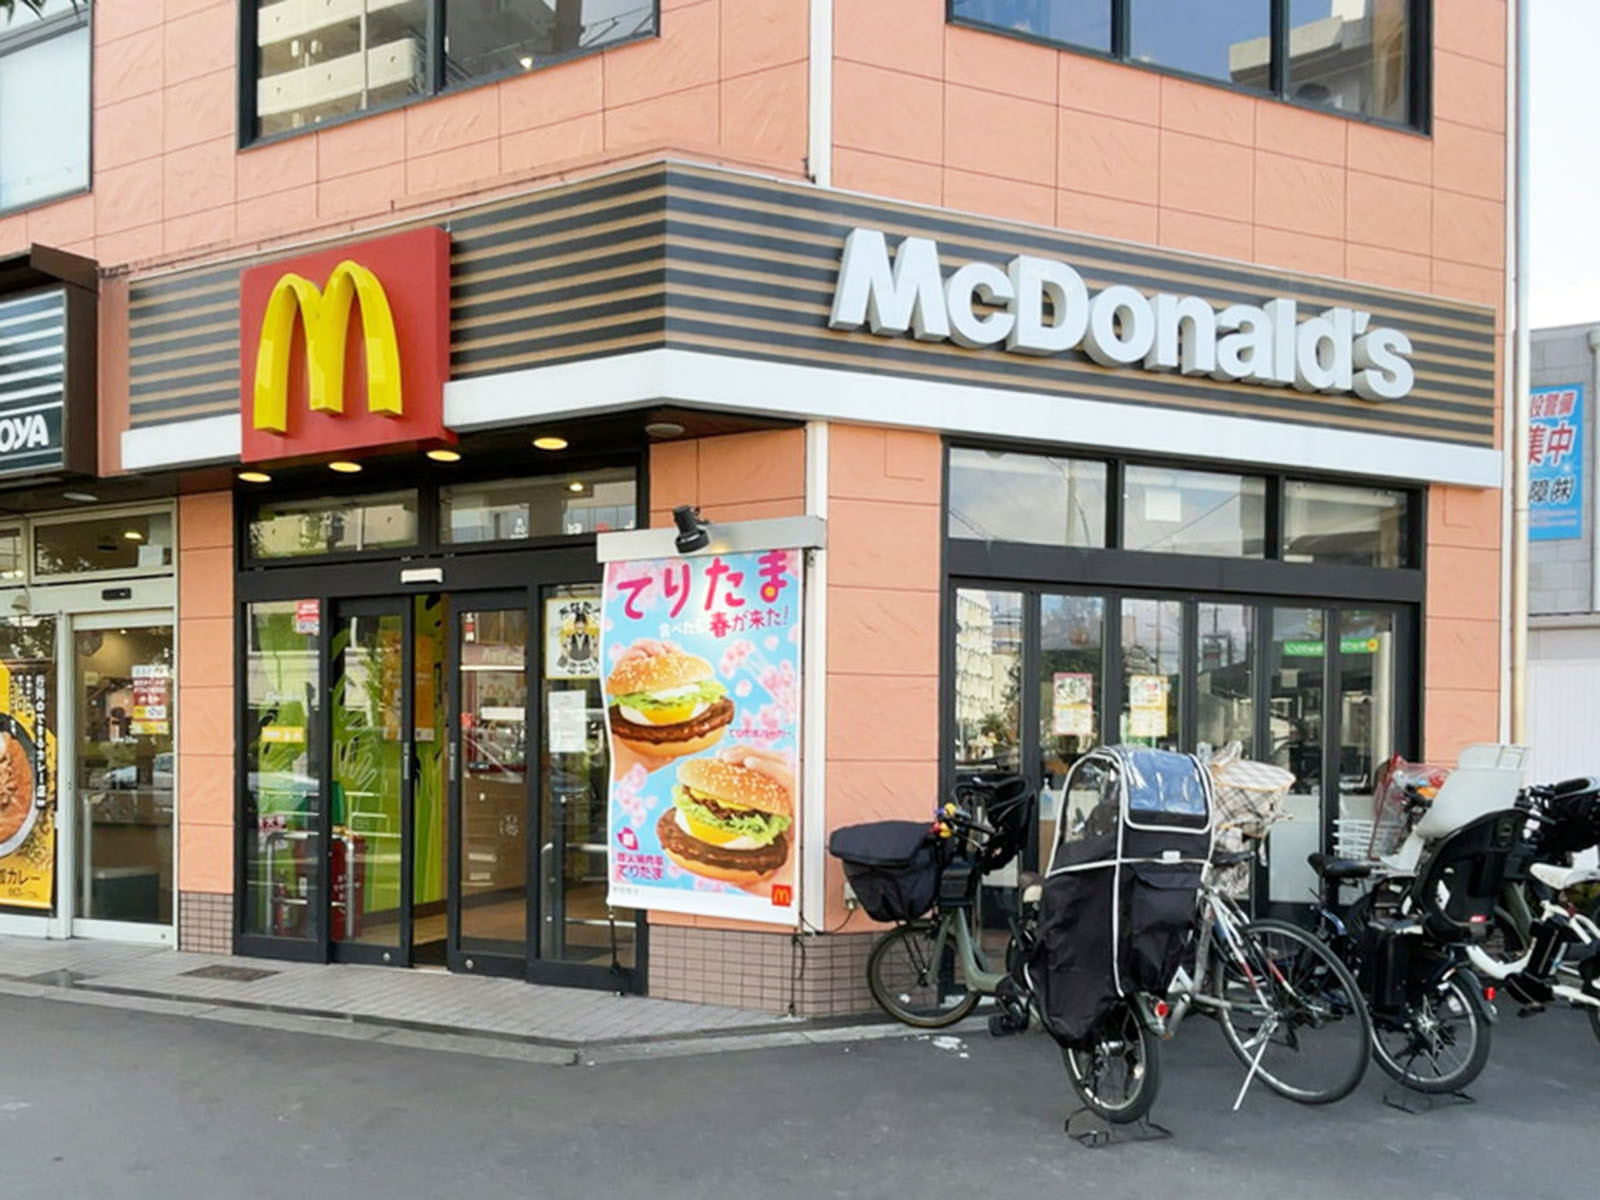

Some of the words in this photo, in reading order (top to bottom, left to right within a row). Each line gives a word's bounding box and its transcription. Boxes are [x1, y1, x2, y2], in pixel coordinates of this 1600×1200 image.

[828, 227, 1415, 400] McDonald's
[616, 550, 788, 620] てりたま
